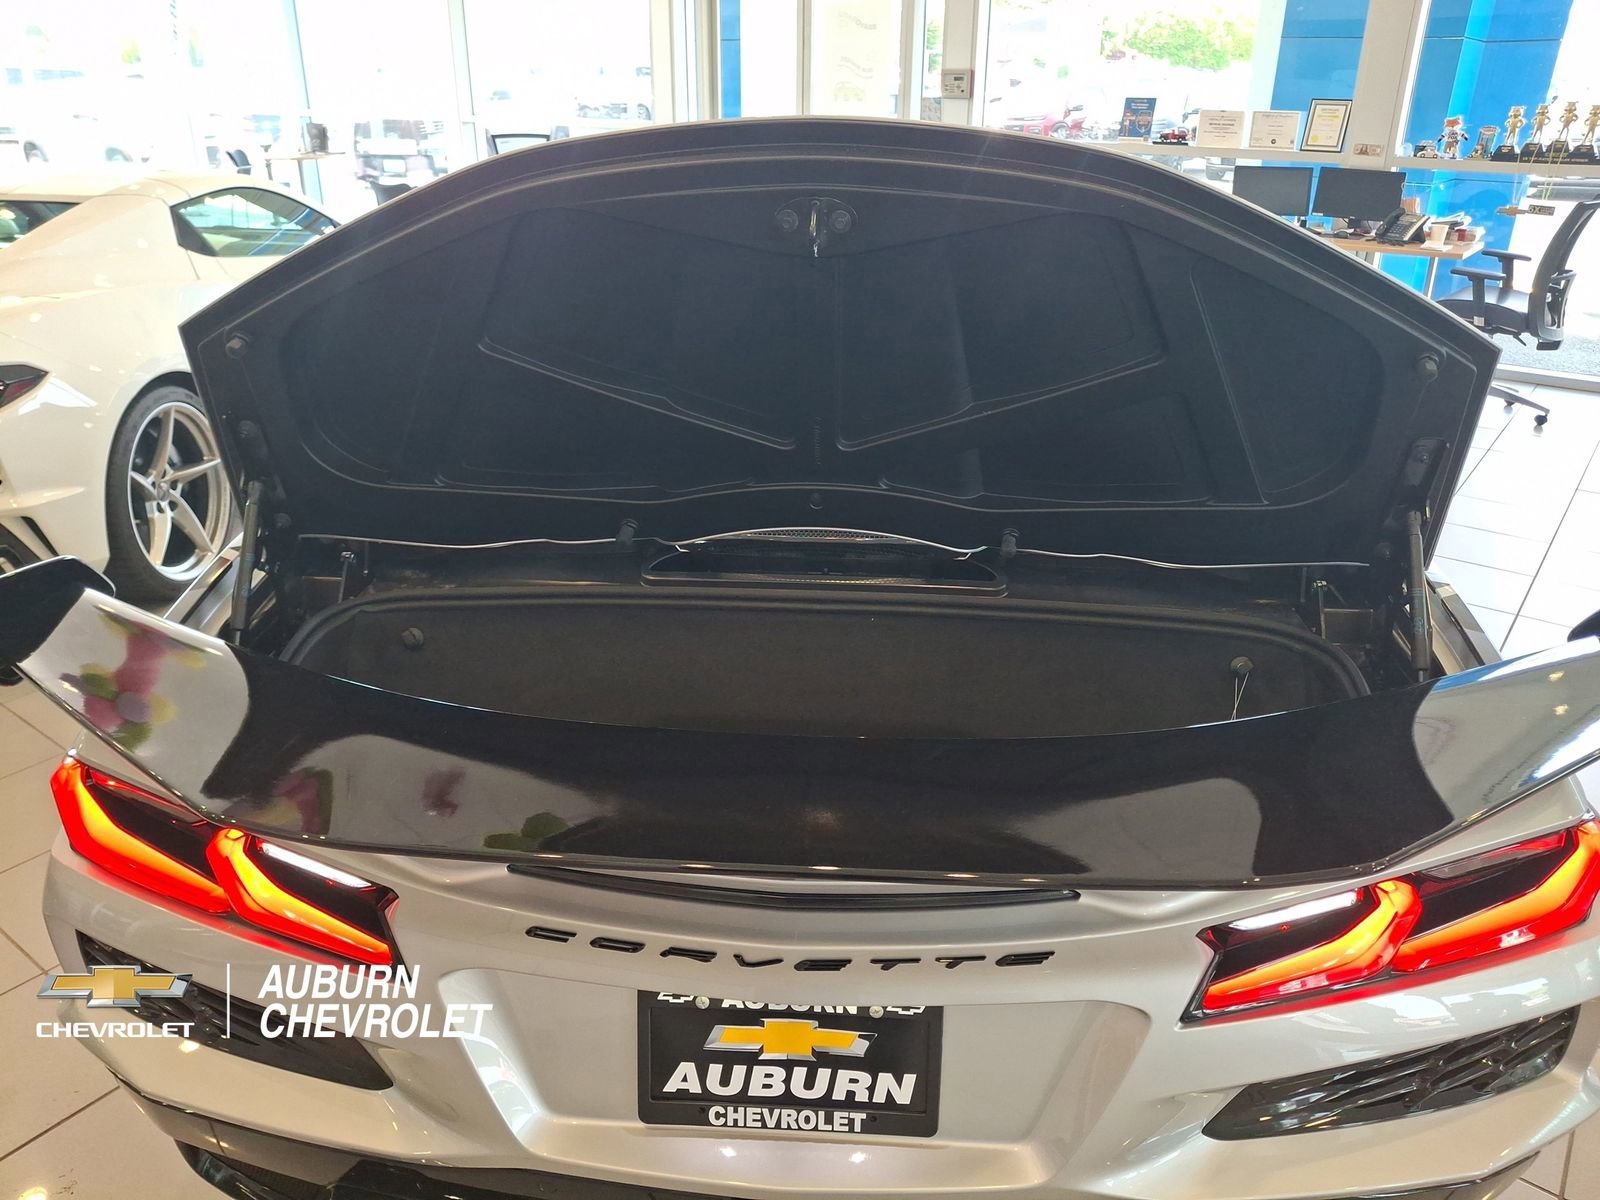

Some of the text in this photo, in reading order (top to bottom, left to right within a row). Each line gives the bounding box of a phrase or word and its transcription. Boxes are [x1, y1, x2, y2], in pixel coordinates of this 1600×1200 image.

[525, 926, 1055, 971] CORVETTE
[662, 1062, 917, 1105] AUBURN
[708, 1106, 867, 1133] CHEVROLET
